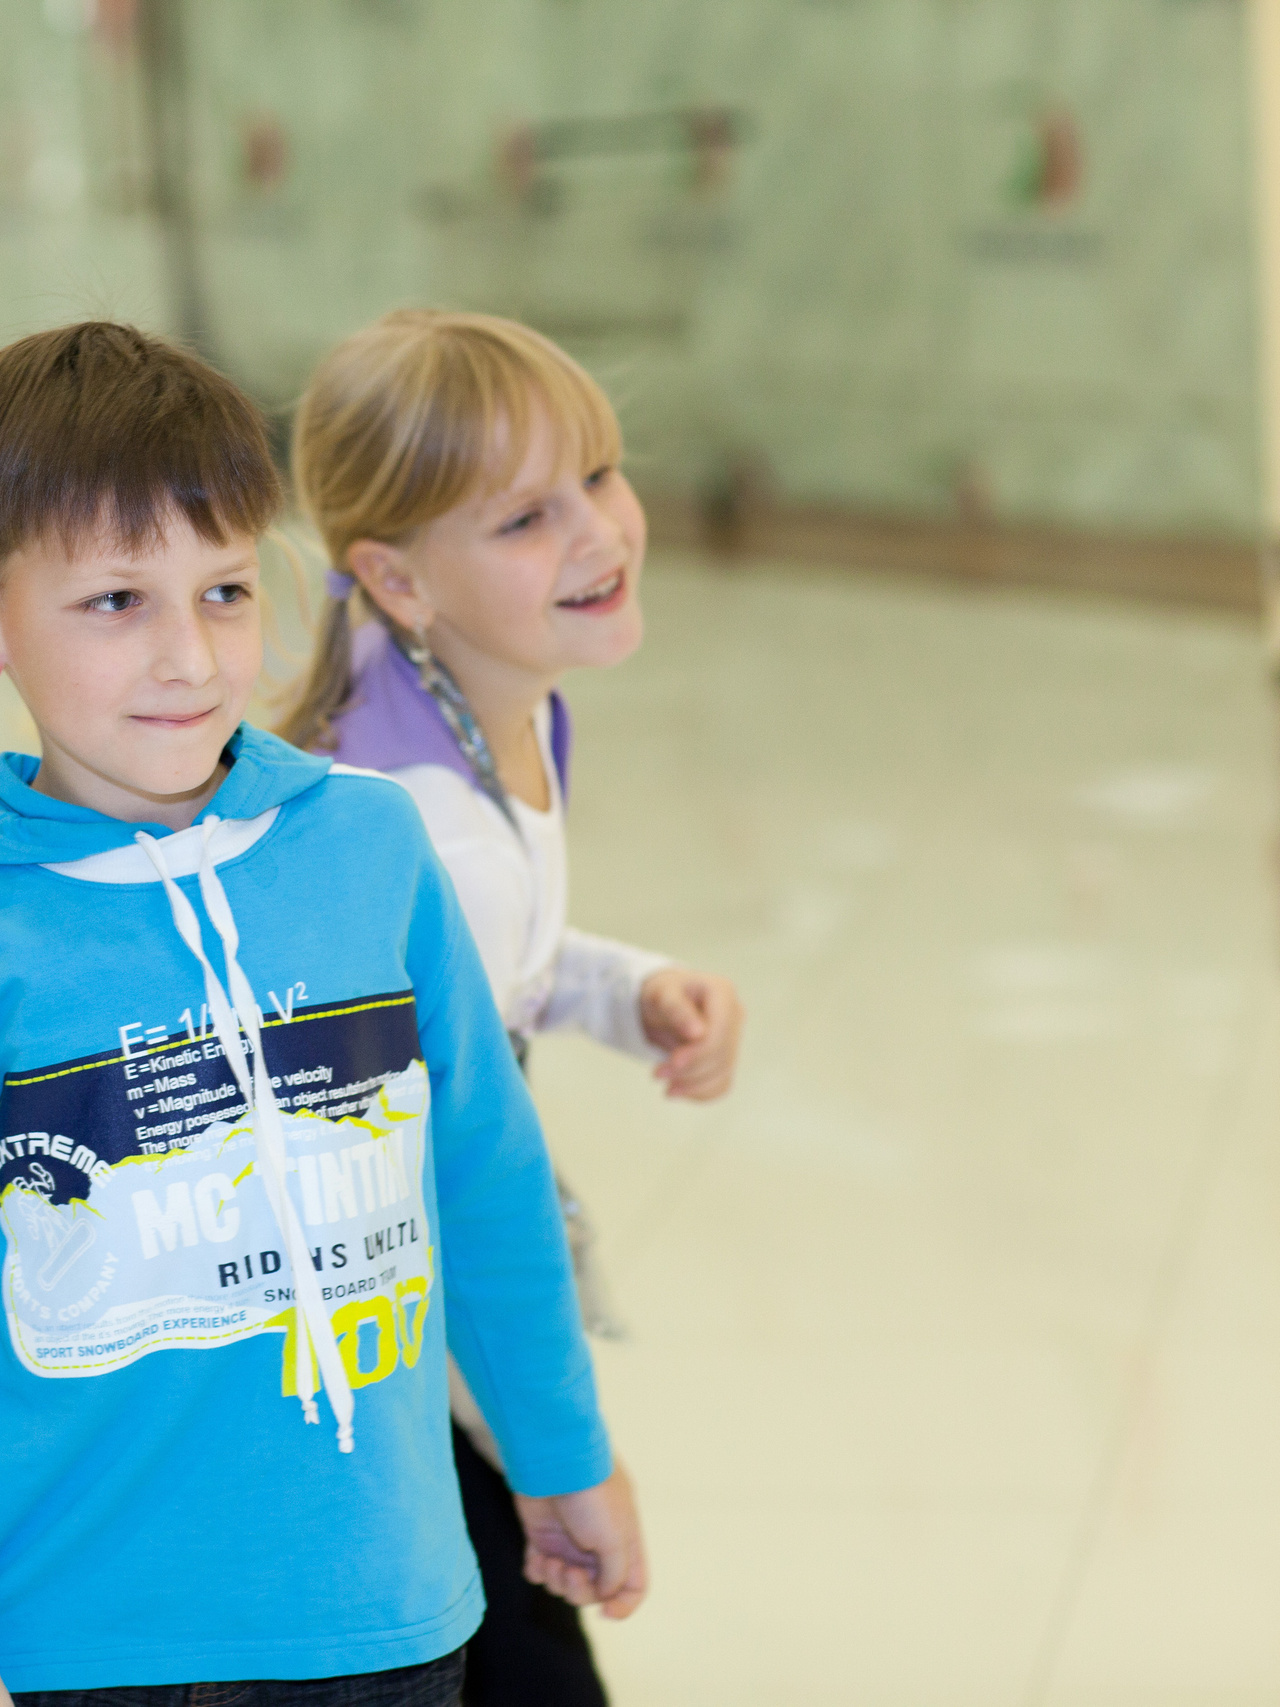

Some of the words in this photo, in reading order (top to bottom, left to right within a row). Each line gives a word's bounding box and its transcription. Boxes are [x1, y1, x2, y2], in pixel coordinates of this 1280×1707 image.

[283, 1065, 333, 1087] velocity
[136, 1120, 183, 1140] Energy
[293, 1089, 328, 1107] object
[137, 1142, 167, 1156] The
[169, 1133, 201, 1149] more
[131, 1172, 240, 1260] MC
[57, 1252, 119, 1322] COMPANY
[36, 1346, 73, 1359] SPORT
[77, 1324, 159, 1358] SNOWBOARD
[163, 1310, 247, 1331] EXPERIENCE
